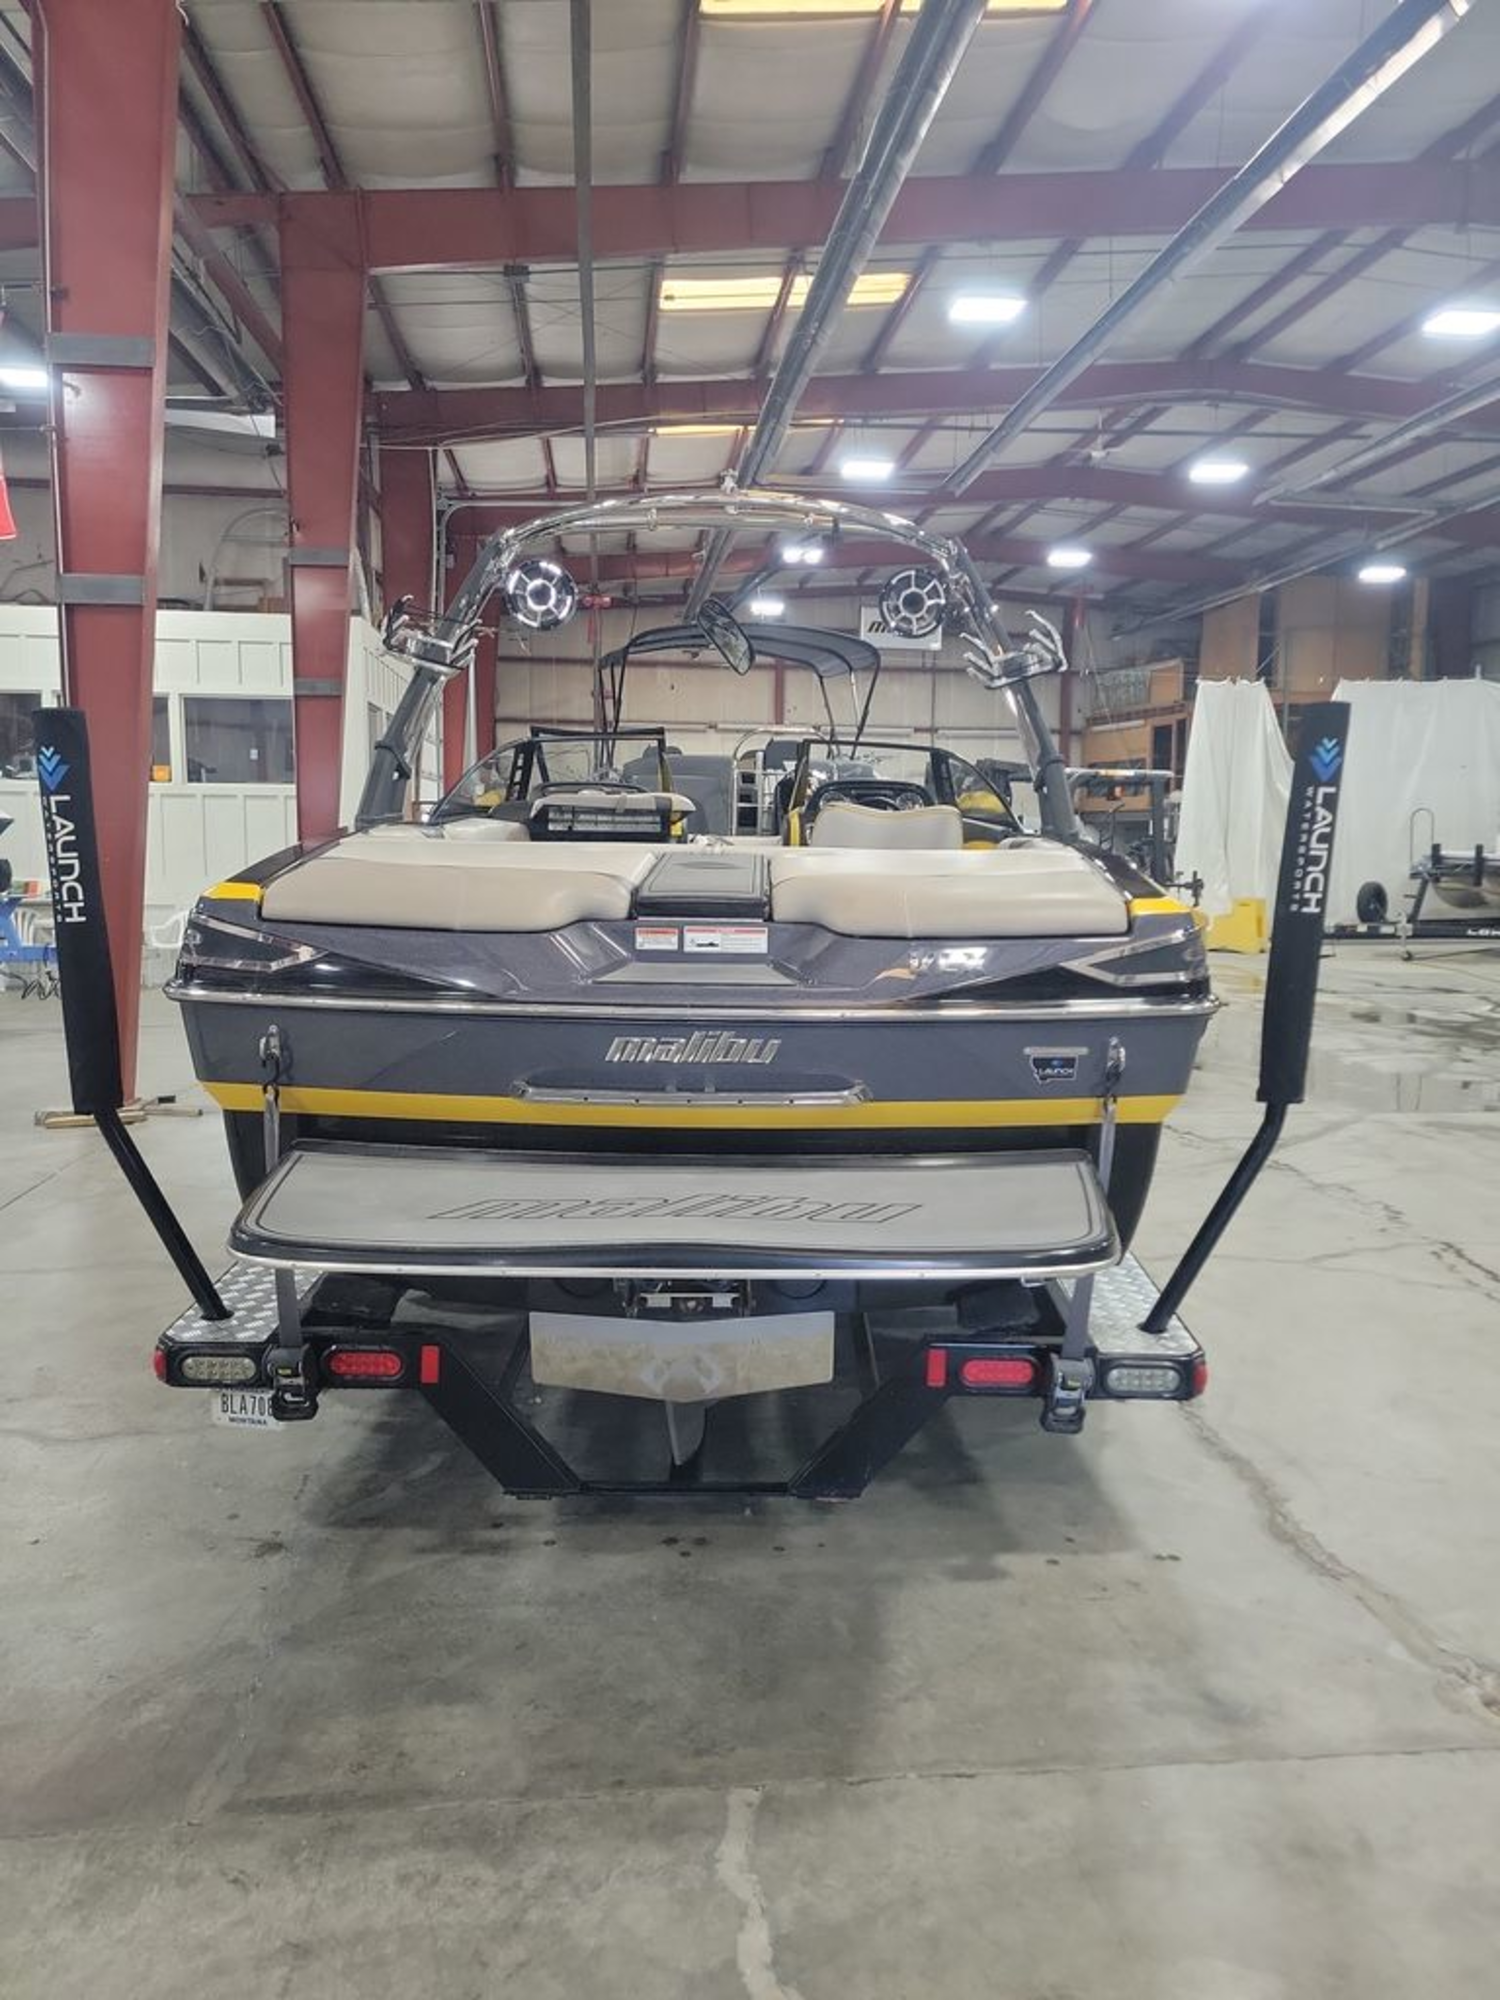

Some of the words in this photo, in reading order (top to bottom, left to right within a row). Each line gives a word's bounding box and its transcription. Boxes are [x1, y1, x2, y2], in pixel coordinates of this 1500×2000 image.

[50, 795, 86, 922] LAUNCH
[1290, 785, 1314, 911] WATERSPORTS
[1302, 786, 1336, 912] LAUNCH
[605, 1030, 781, 1064] malibu
[427, 1193, 922, 1223] malibu
